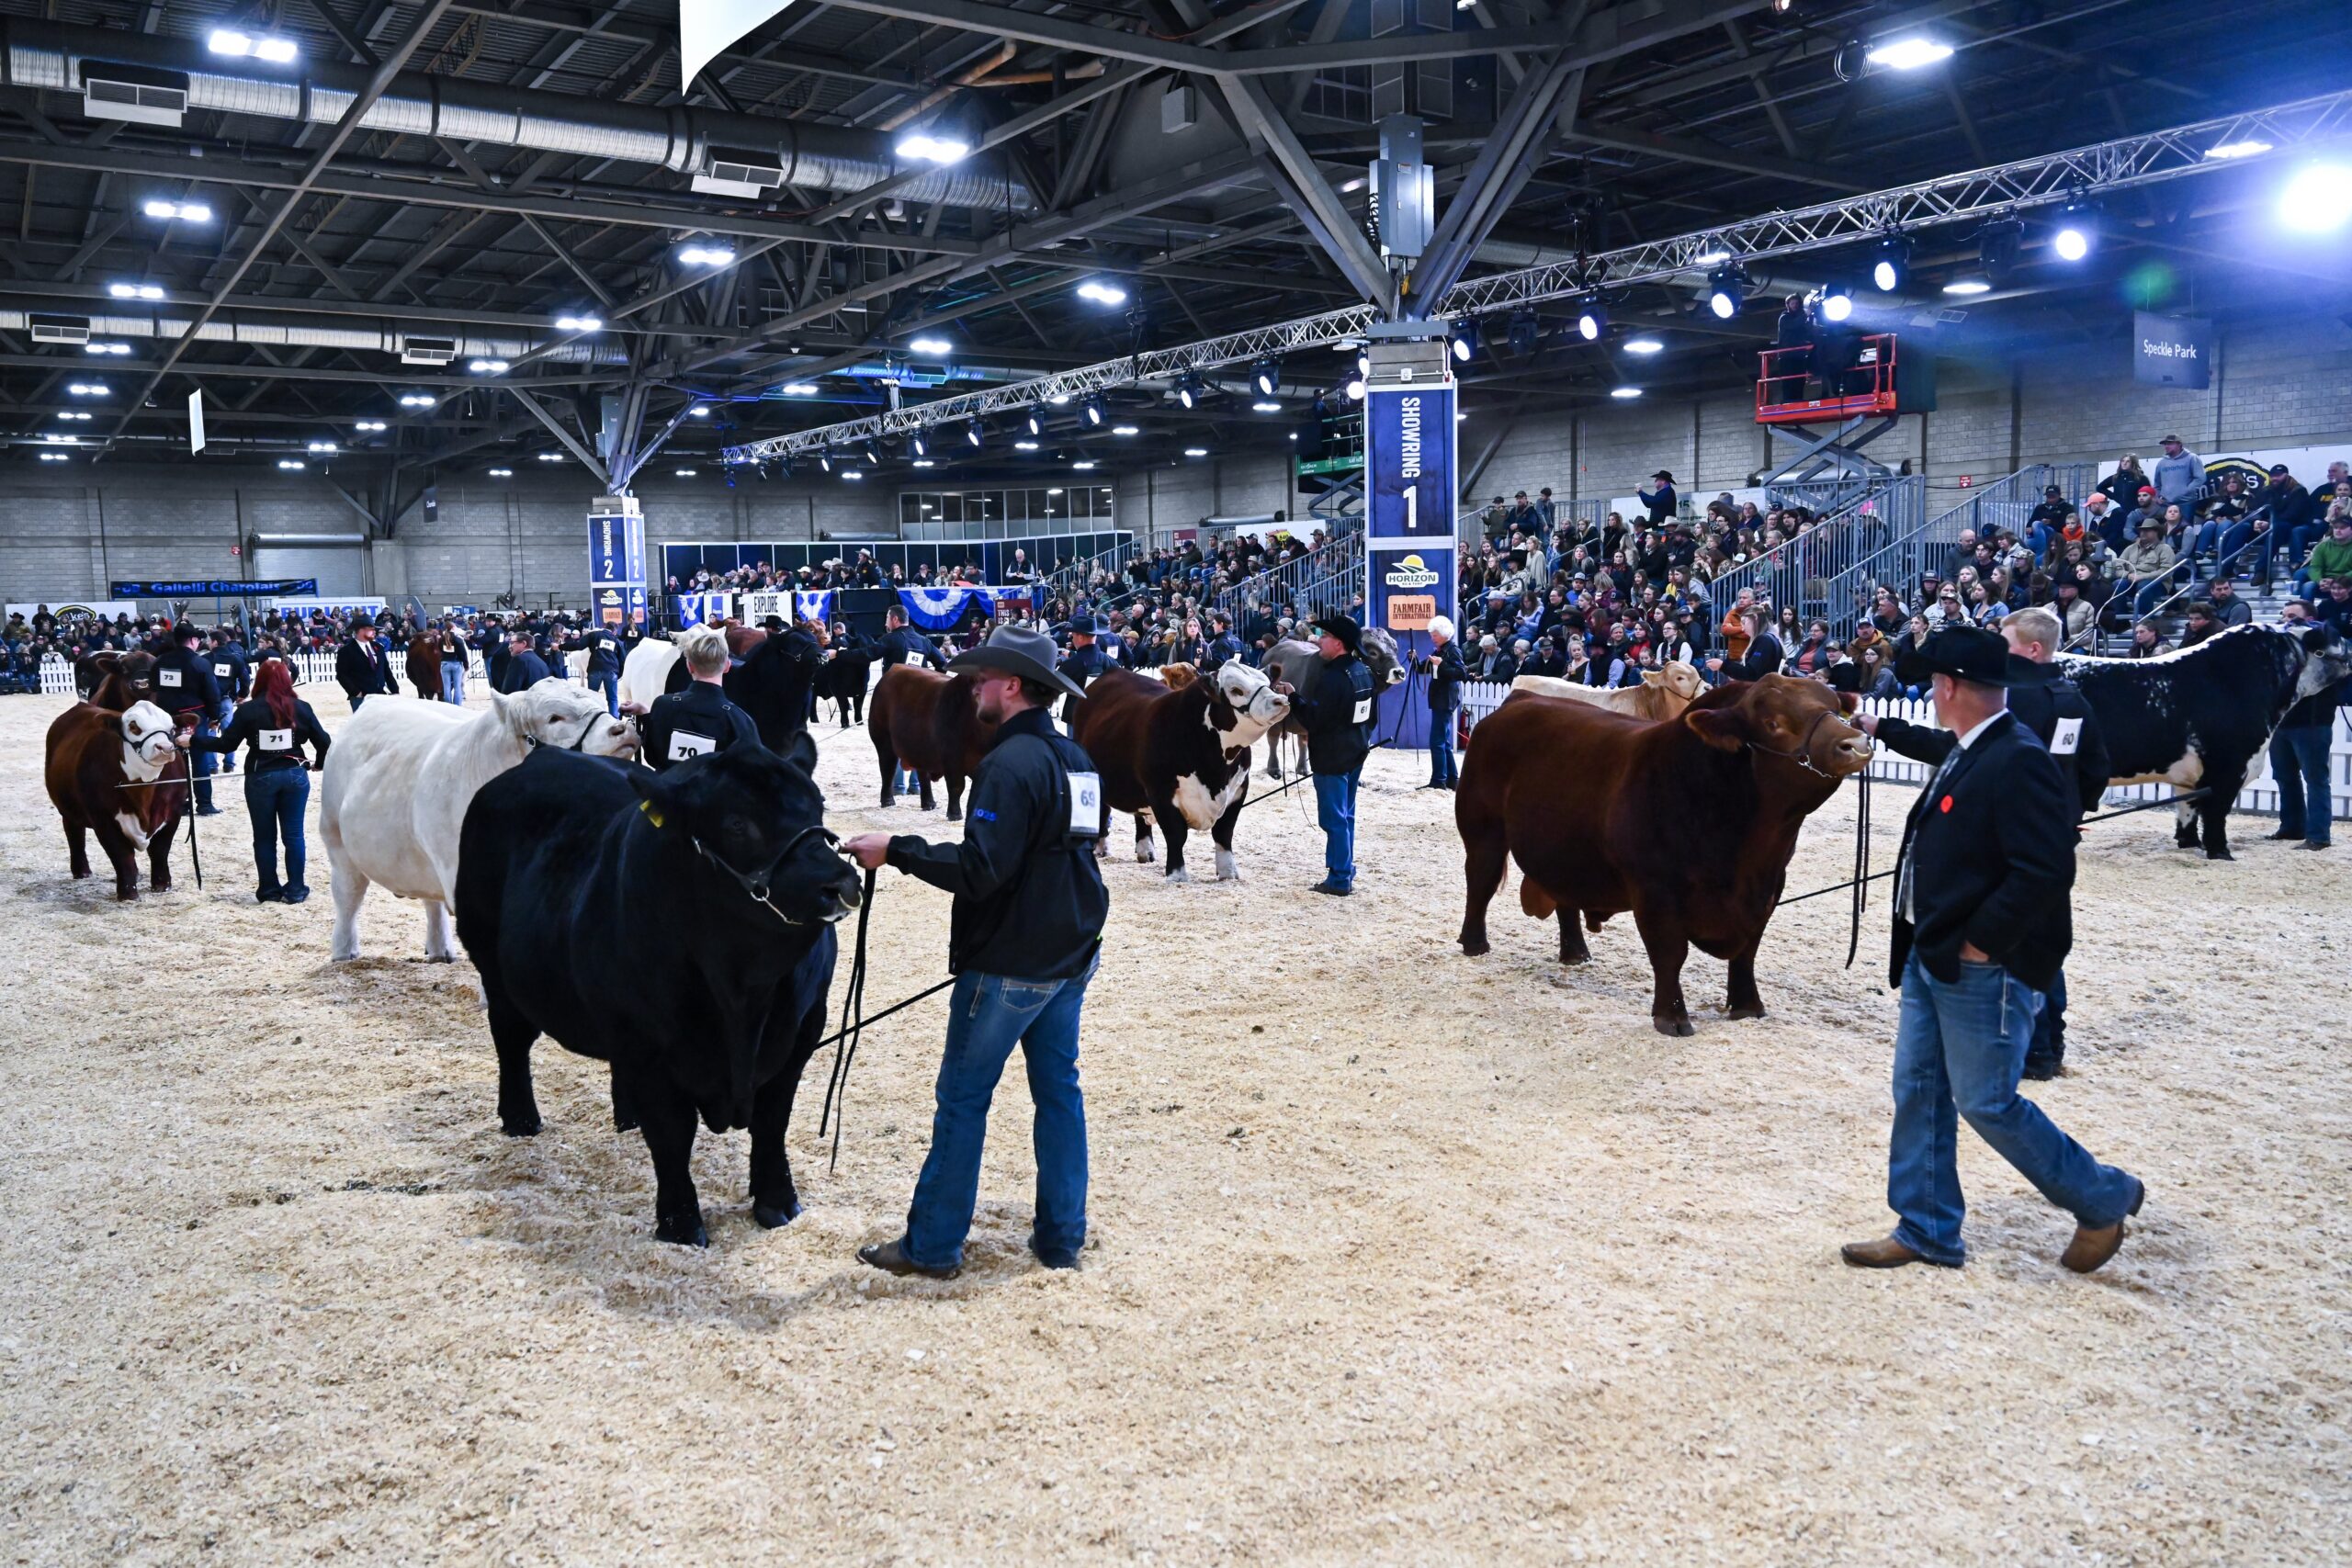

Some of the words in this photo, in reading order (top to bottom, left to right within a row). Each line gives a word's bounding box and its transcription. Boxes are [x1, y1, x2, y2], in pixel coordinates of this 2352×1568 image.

[2143, 338, 2173, 357] Speckle
[2175, 344, 2198, 359] Park
[1401, 397, 1420, 479] SHOWRING
[1403, 485, 1417, 528] 1
[603, 520, 612, 557] SHOWRING
[604, 558, 614, 579] 2
[633, 558, 639, 579] 2
[151, 581, 206, 593] Gallelli
[1388, 574, 1436, 582] HORIZON
[754, 595, 778, 613] EXPLORE
[1393, 603, 1430, 614] FARMFAIR
[269, 734, 283, 743] 71
[2062, 732, 2075, 746] 60
[677, 746, 698, 758] 70
[1080, 789, 1096, 807] 69
